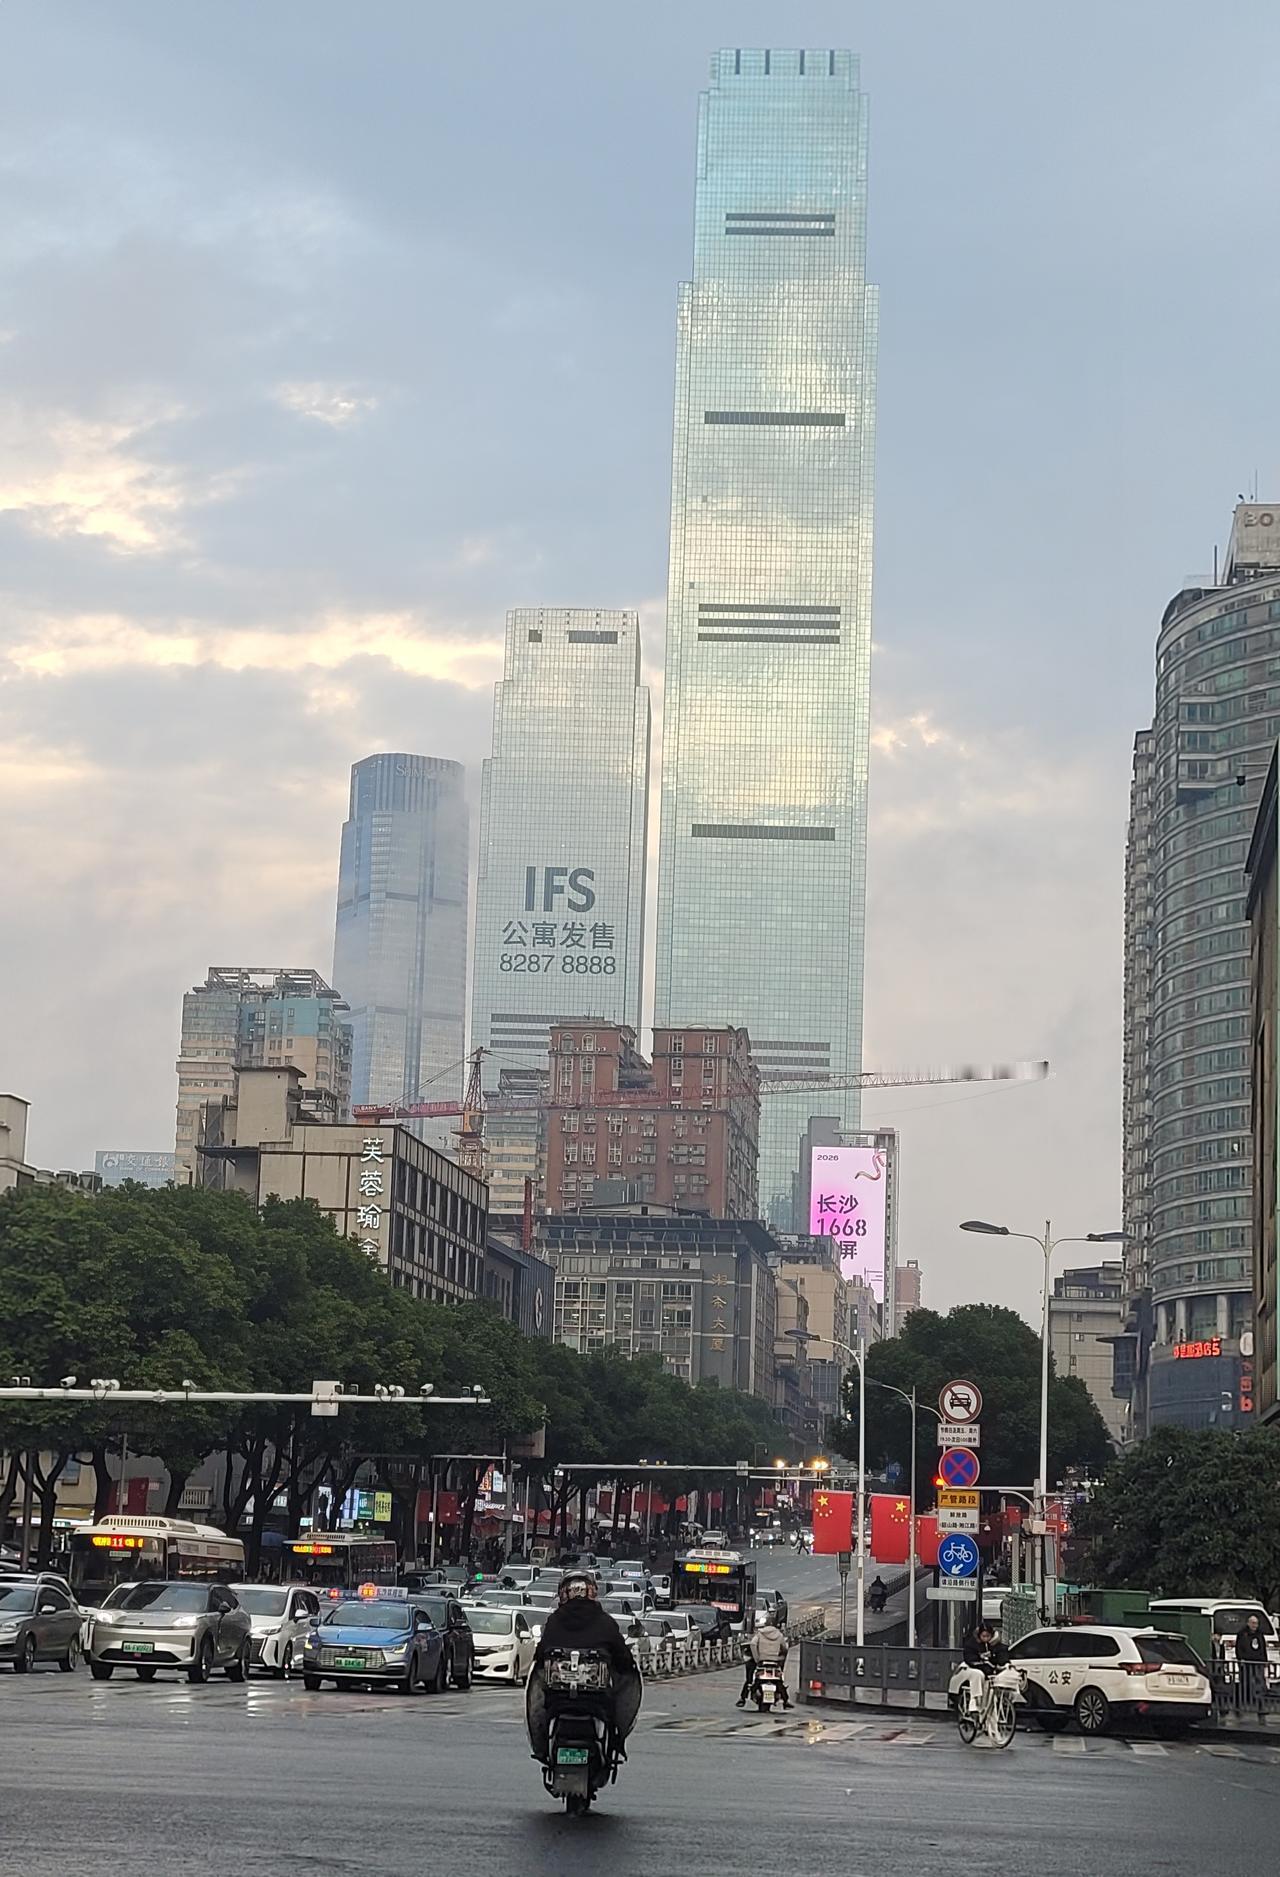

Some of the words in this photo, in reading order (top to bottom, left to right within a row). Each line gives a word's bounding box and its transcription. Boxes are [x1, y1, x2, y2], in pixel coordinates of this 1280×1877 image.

[524, 866, 596, 913] IFS
[502, 920, 615, 950] 公寓发售
[499, 953, 555, 973] 8287
[561, 955, 616, 975] 8888
[817, 1194, 859, 1214] 长沙
[817, 1218, 867, 1237] 1668
[840, 1240, 858, 1260] 屏
[940, 1494, 977, 1505] 严管路段
[1048, 1669, 1072, 1686] 公安
